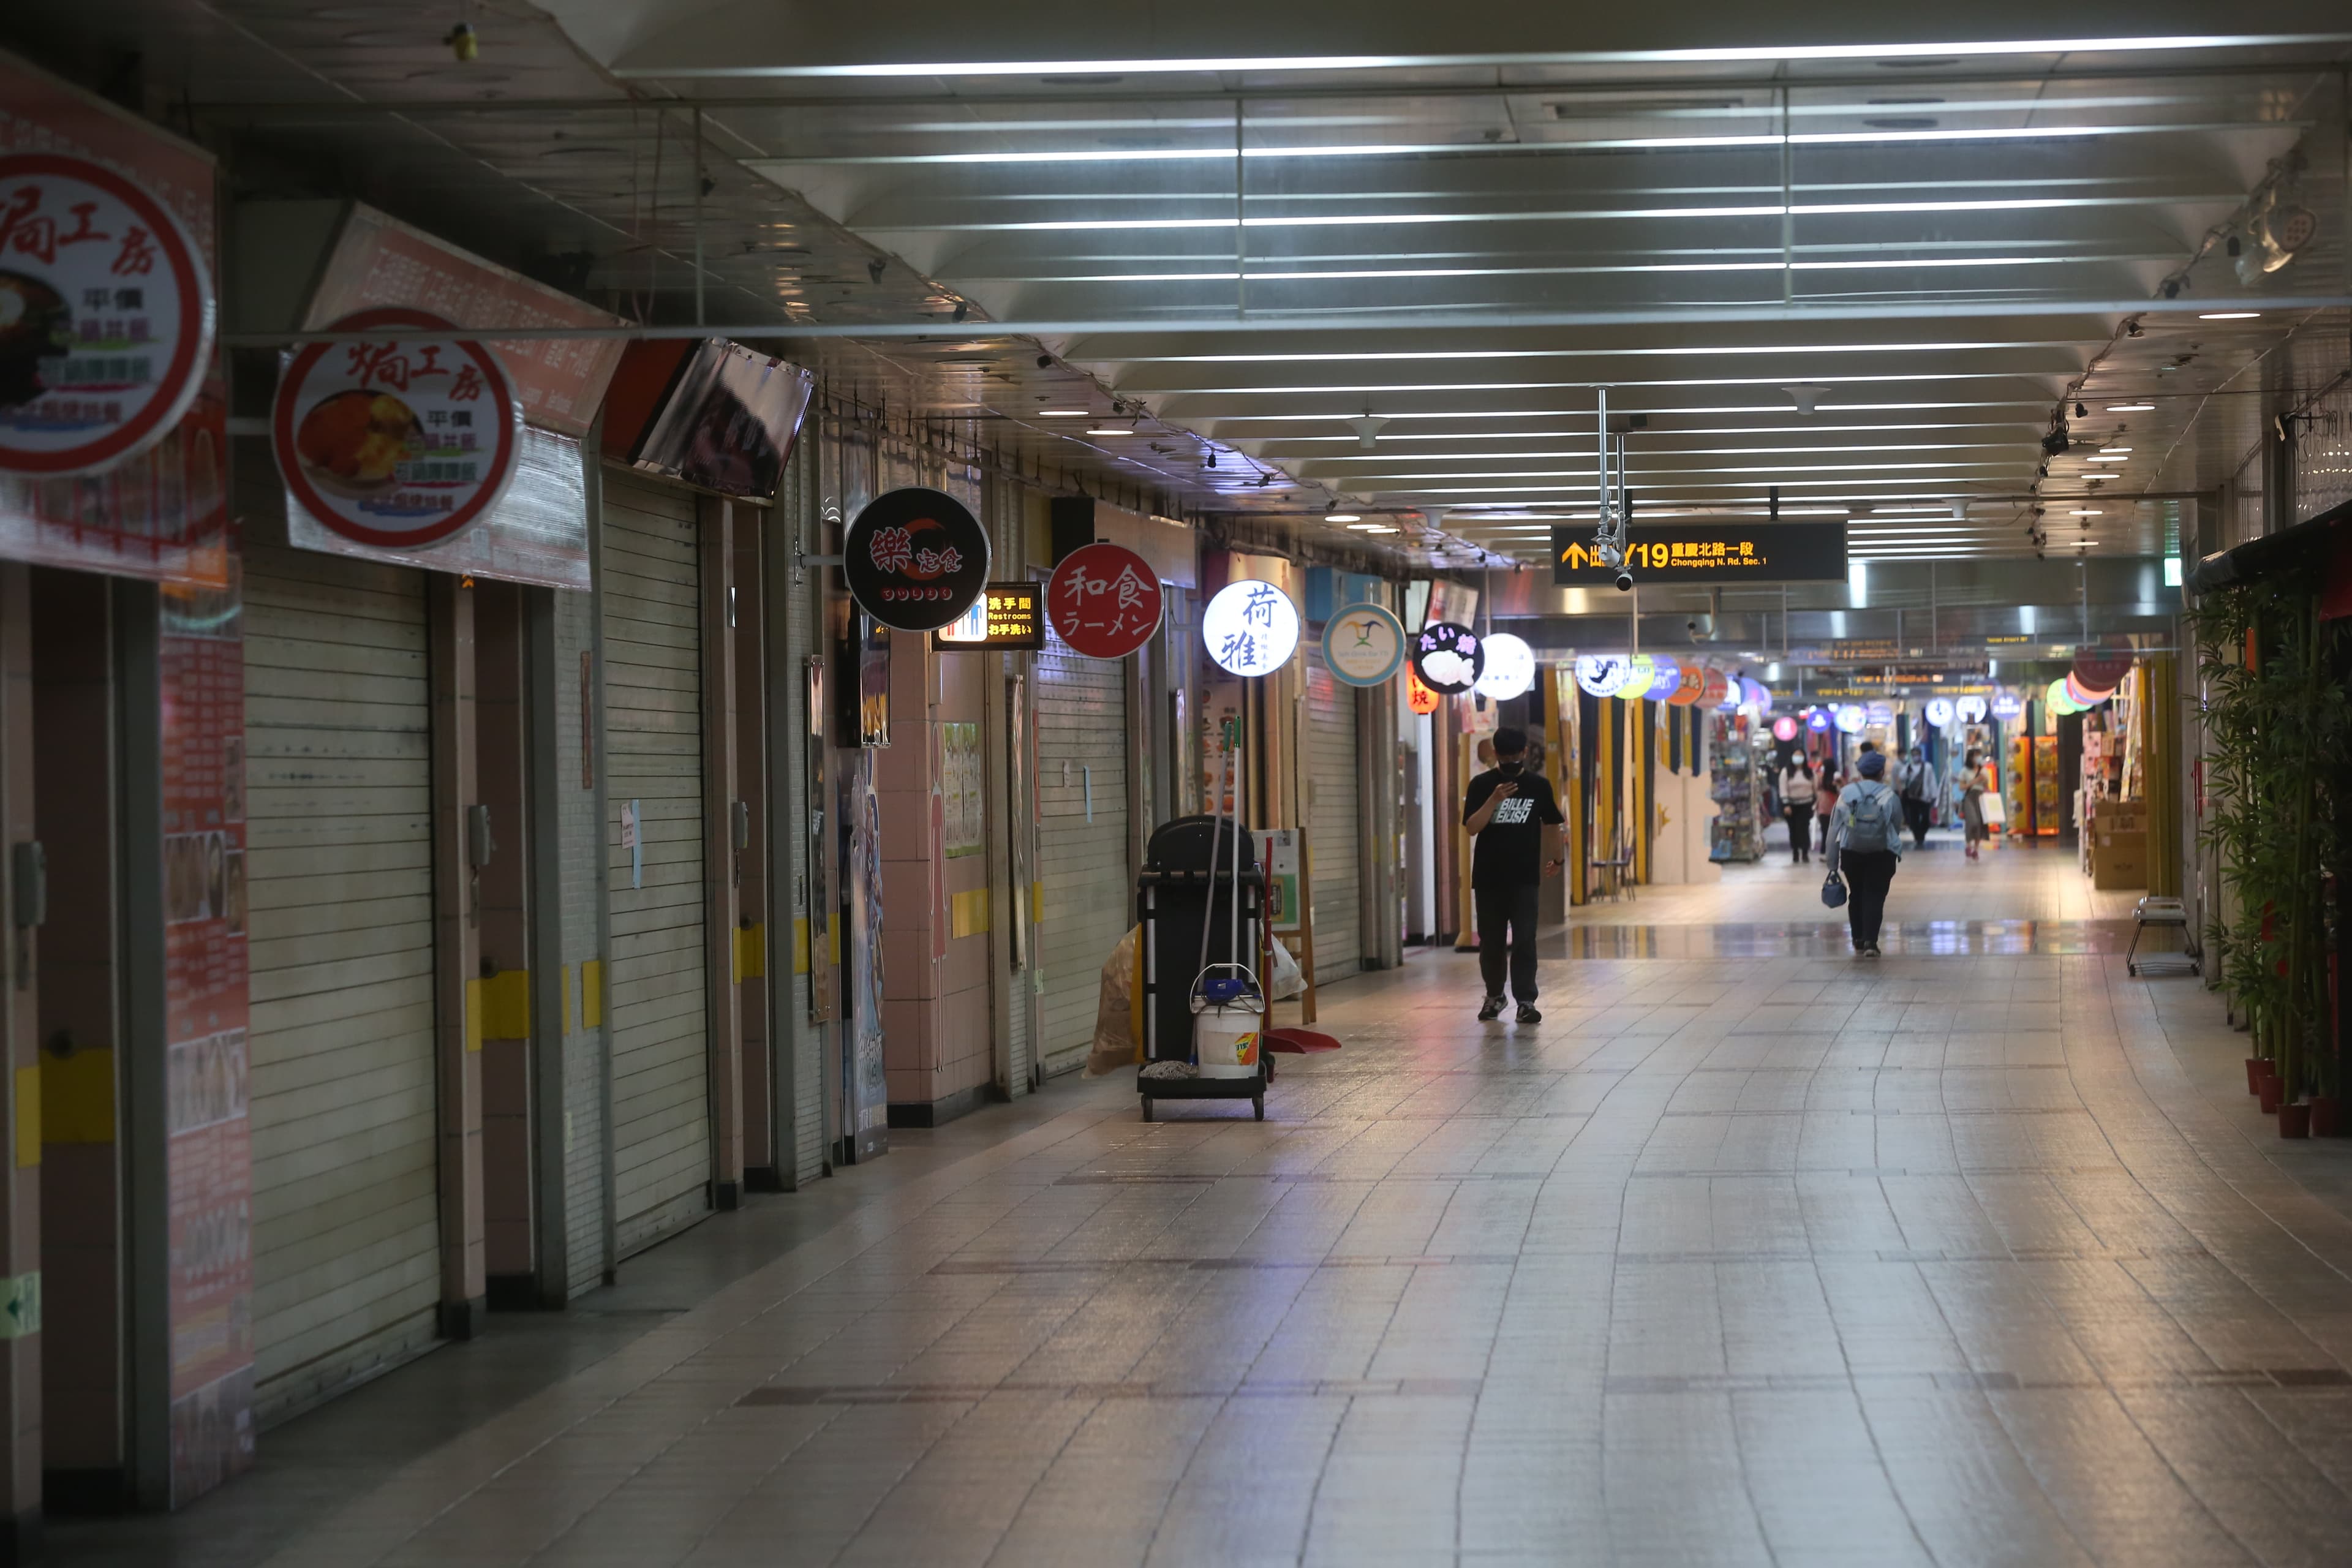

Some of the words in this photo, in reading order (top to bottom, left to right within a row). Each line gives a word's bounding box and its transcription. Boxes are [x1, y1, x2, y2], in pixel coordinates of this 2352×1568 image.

[1671, 542, 1754, 557] 重慶北路一段
[1671, 558, 1715, 567] Chongqing
[1728, 557, 1741, 566] Rd.
[1064, 564, 1154, 609] 和食
[989, 597, 1031, 610] 洗手間
[988, 612, 1031, 620] Restrooms
[988, 624, 1031, 636] お手洗い
[1063, 611, 1152, 636] ラーメン
[1499, 798, 1534, 811] BILLIE
[1495, 810, 1531, 823] EILISH
